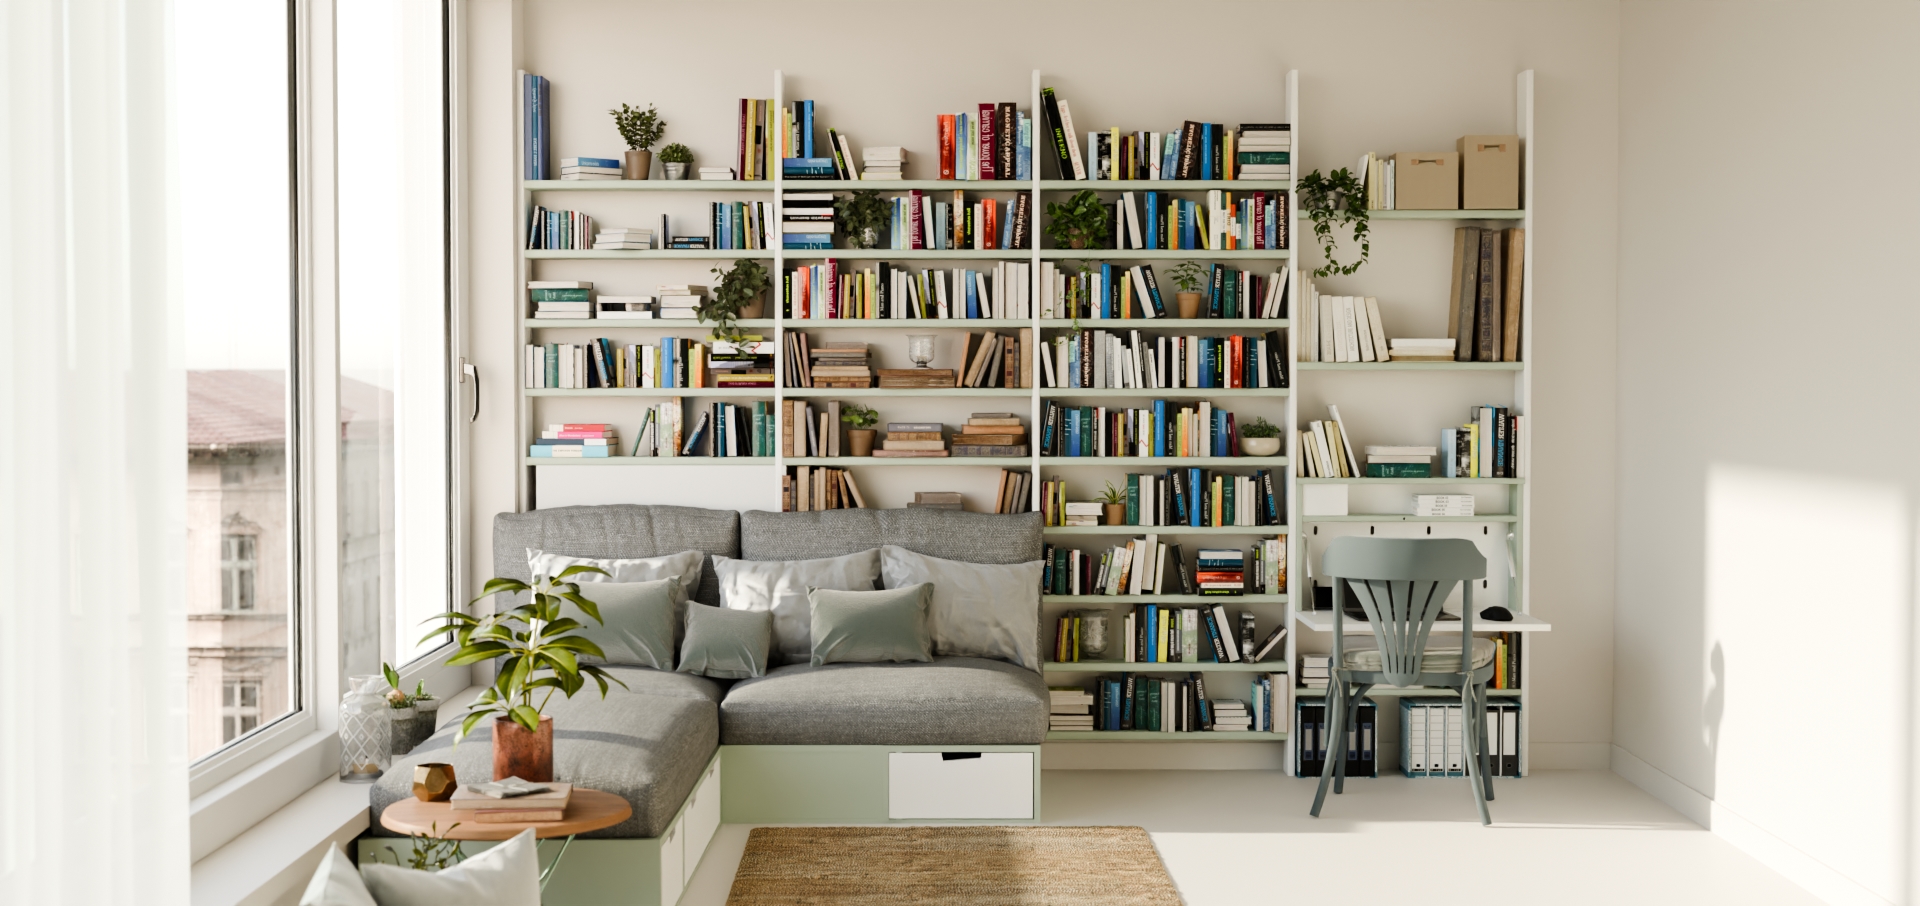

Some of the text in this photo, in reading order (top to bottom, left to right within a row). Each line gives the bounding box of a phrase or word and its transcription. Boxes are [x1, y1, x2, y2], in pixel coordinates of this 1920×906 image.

[1004, 106, 1012, 146] MAGNETIC
[1054, 127, 1068, 160] INFERNO
[1173, 473, 1182, 494] WALTER
[1264, 474, 1273, 494] WALTER
[1214, 638, 1224, 658] WALTER
[1195, 678, 1204, 700] WALTER
